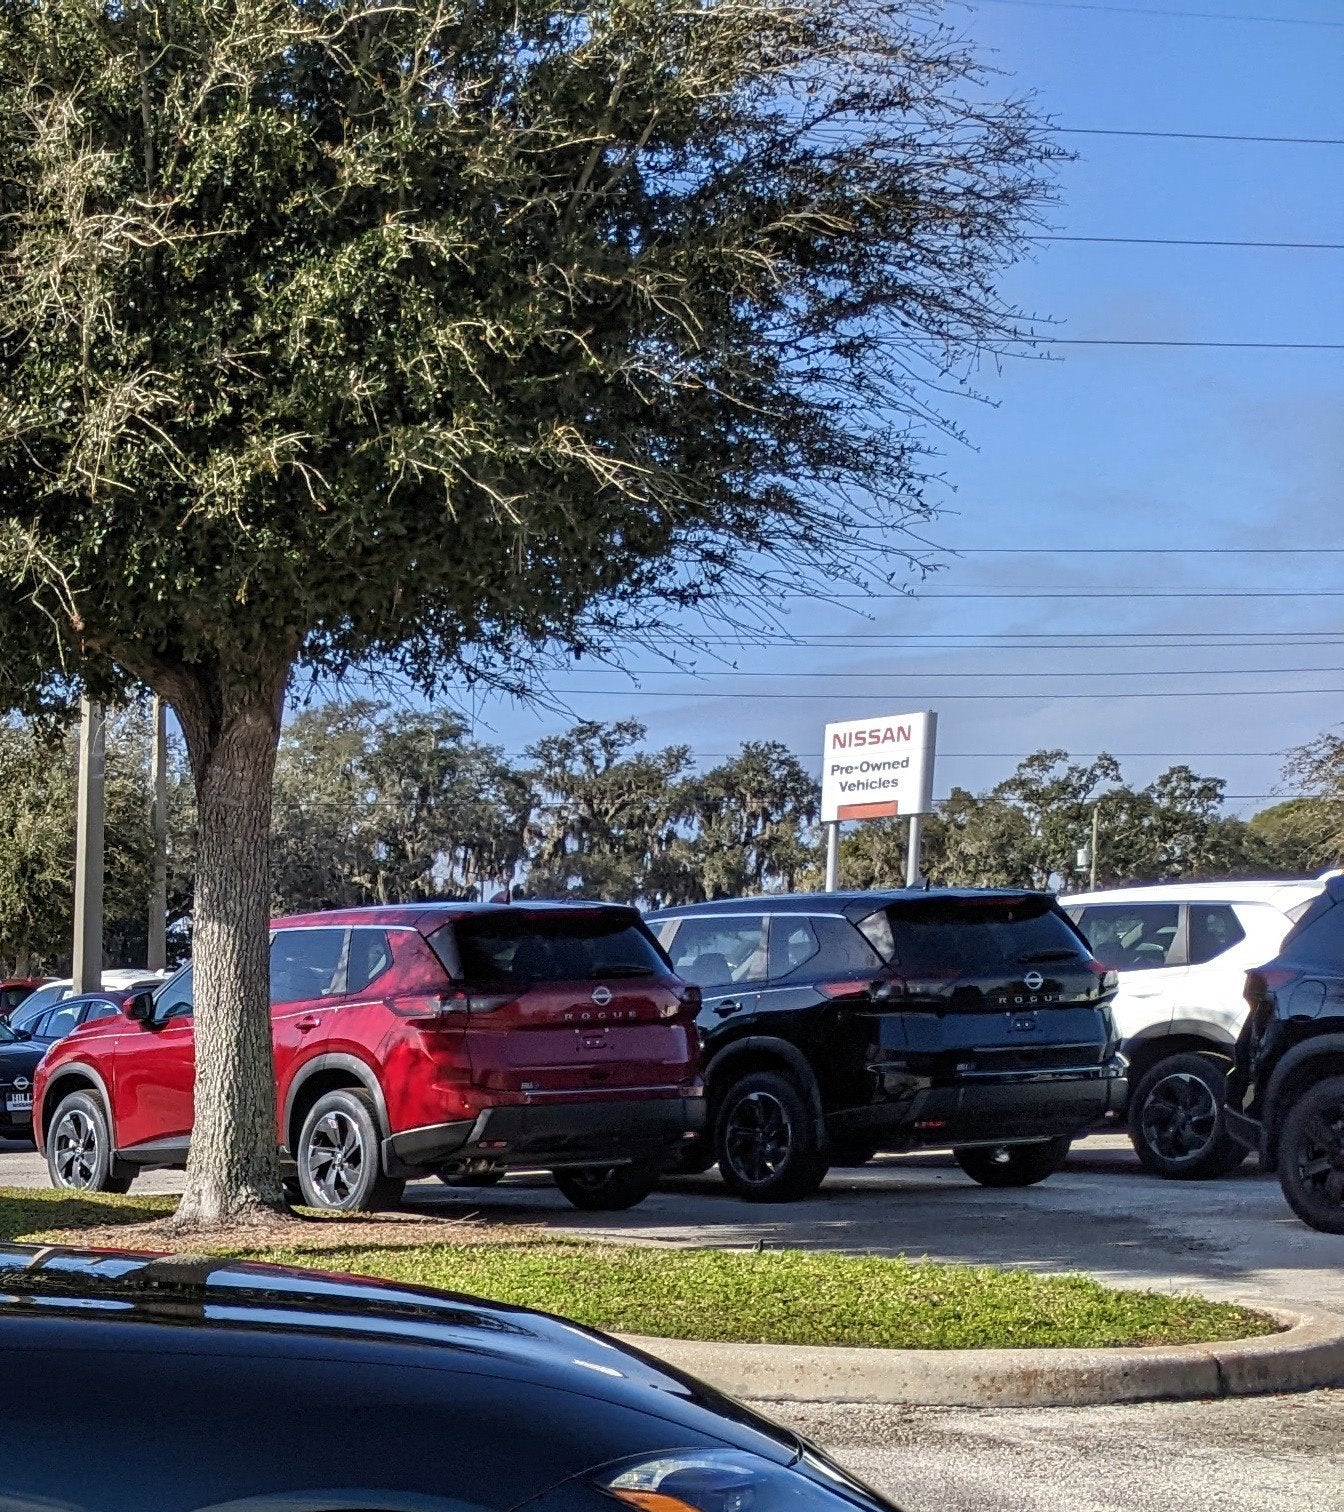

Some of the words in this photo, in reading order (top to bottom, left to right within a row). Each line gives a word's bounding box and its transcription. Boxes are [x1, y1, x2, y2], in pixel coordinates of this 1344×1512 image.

[832, 725, 911, 749] NISSAN
[831, 757, 909, 776] Pre-Owned
[839, 778, 898, 792] Vehicles
[999, 994, 1064, 1003] ROGUE
[564, 1010, 637, 1020] ROGUE
